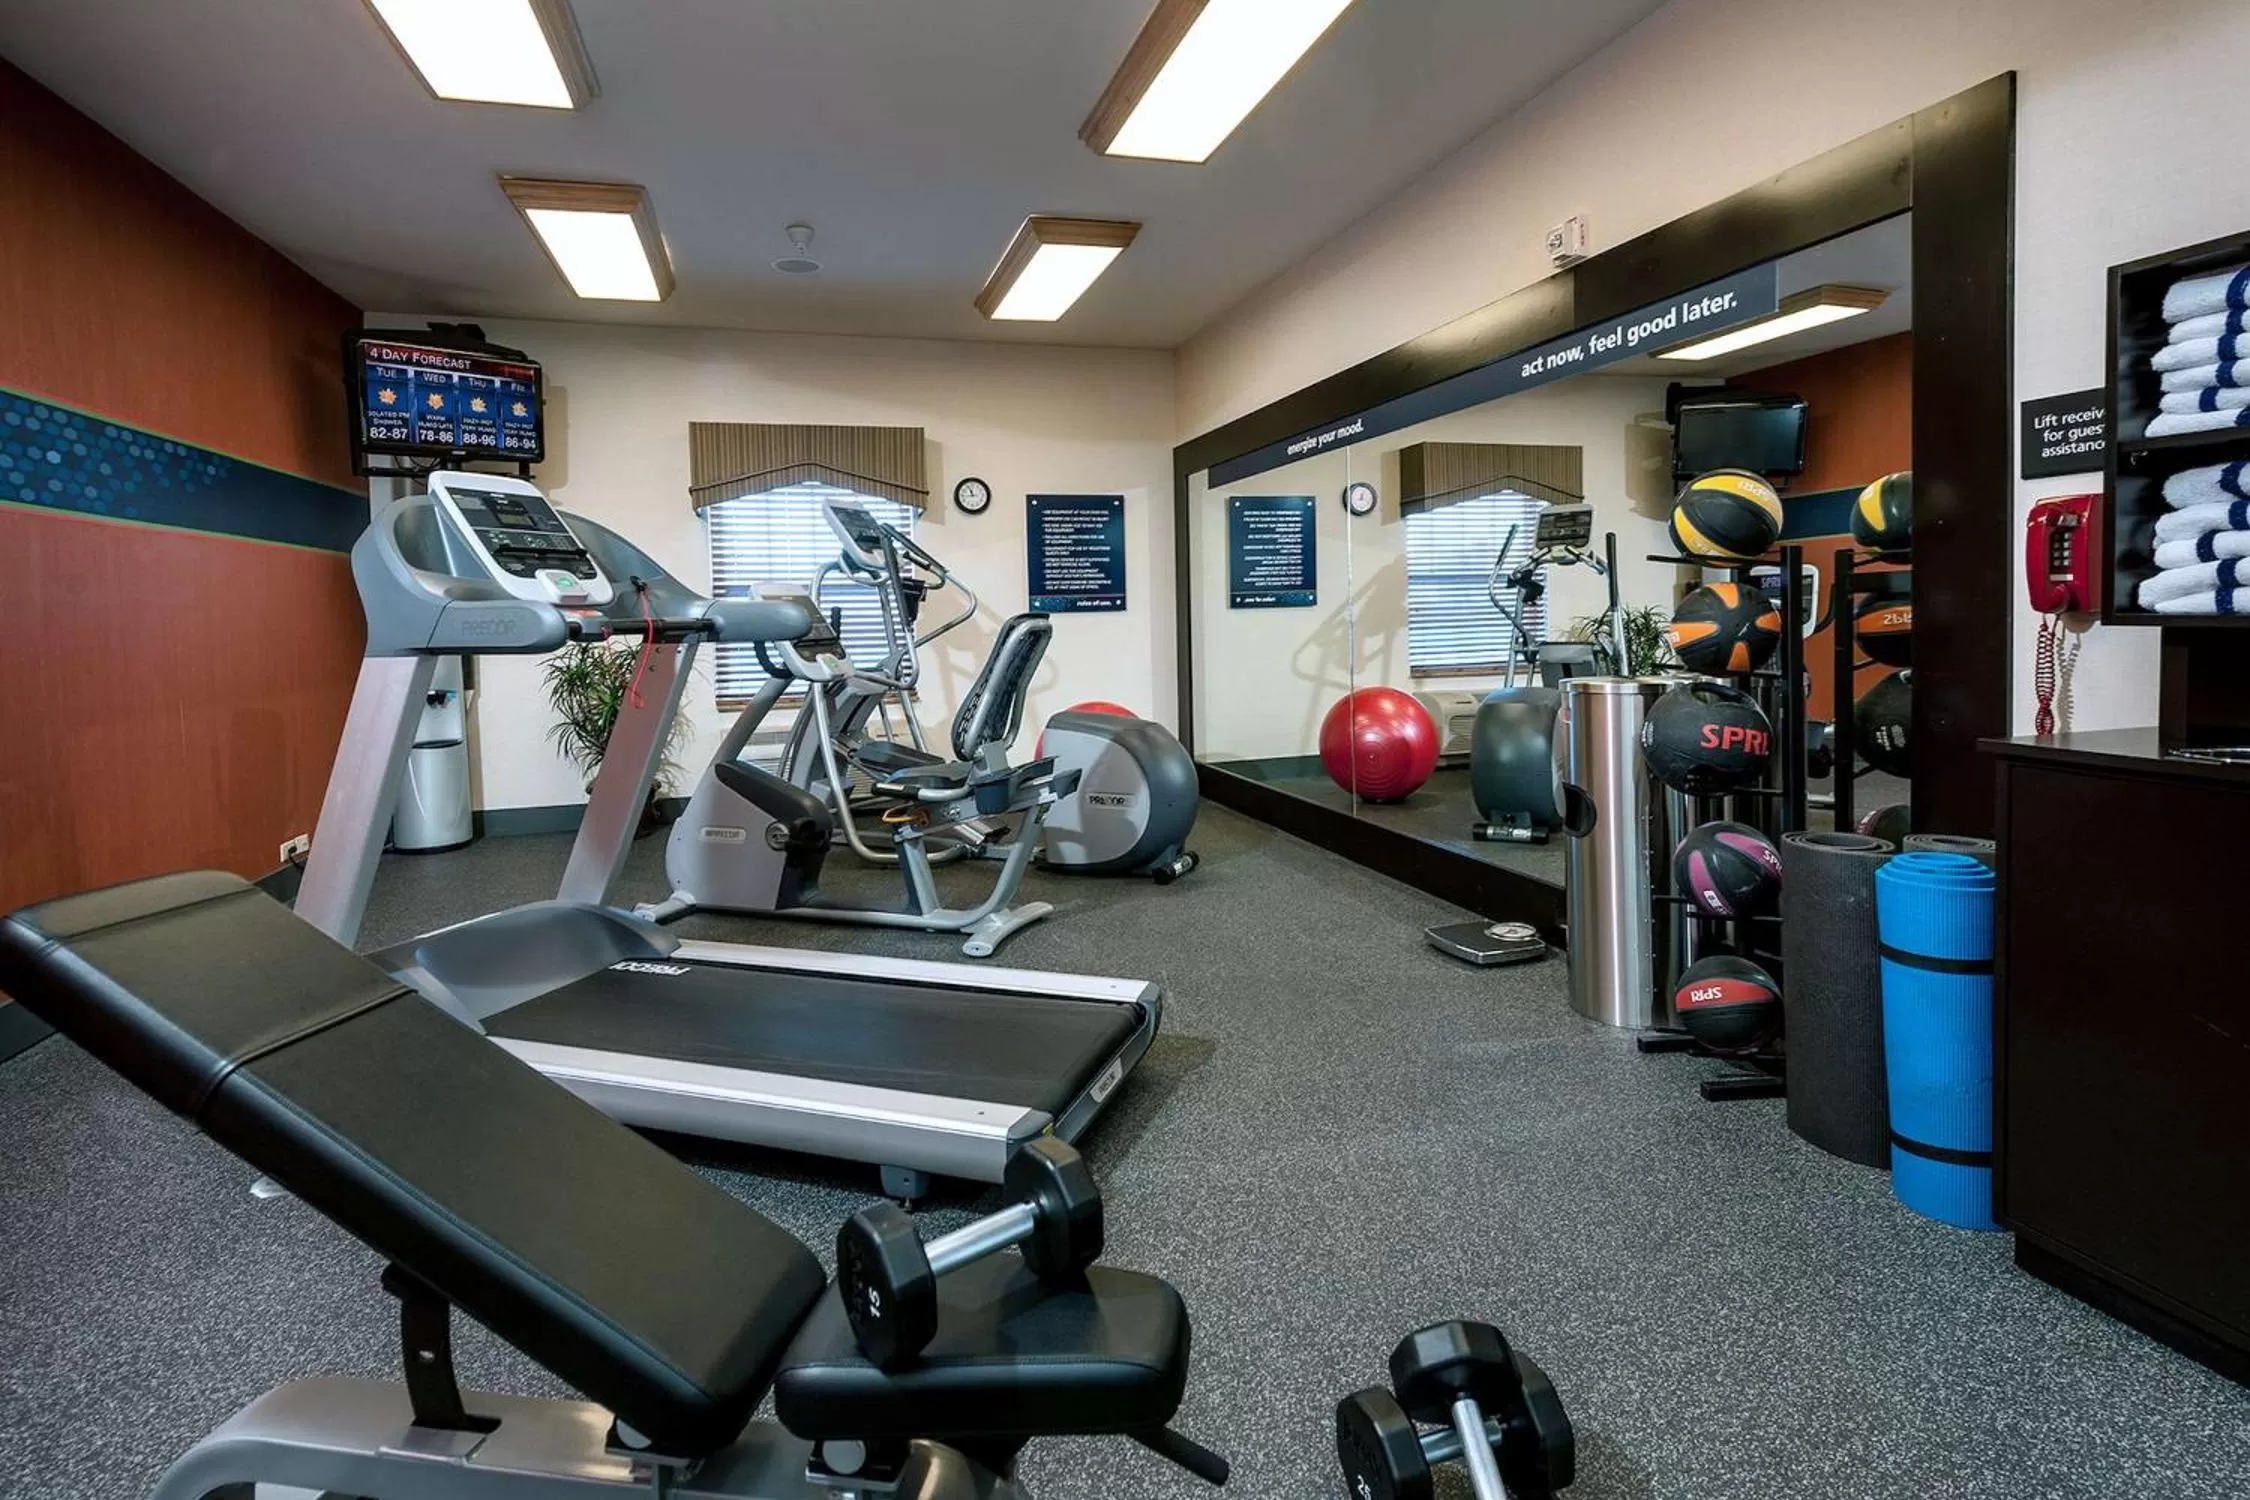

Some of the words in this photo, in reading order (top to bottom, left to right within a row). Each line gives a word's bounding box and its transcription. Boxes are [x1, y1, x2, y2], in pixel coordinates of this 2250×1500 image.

[1521, 356, 1544, 377] act
[1546, 345, 1584, 369] now,
[1588, 326, 1622, 355] feel
[1627, 307, 1676, 346] good
[1682, 291, 1738, 323] later.
[370, 348, 378, 358] 4
[412, 351, 471, 370] FORECAST
[376, 367, 397, 378] TUE
[423, 372, 446, 383] WED
[469, 377, 487, 388] THU
[2034, 413, 2059, 429] Lift
[370, 426, 408, 439] 82-87
[420, 429, 454, 442] 78-86
[1318, 429, 1337, 448] your
[2043, 429, 2064, 442] for
[2042, 440, 2105, 458] assistanc
[1700, 723, 1769, 756] SPRI
[1690, 986, 1722, 1003] SPRI
[868, 1287, 881, 1319] 15
